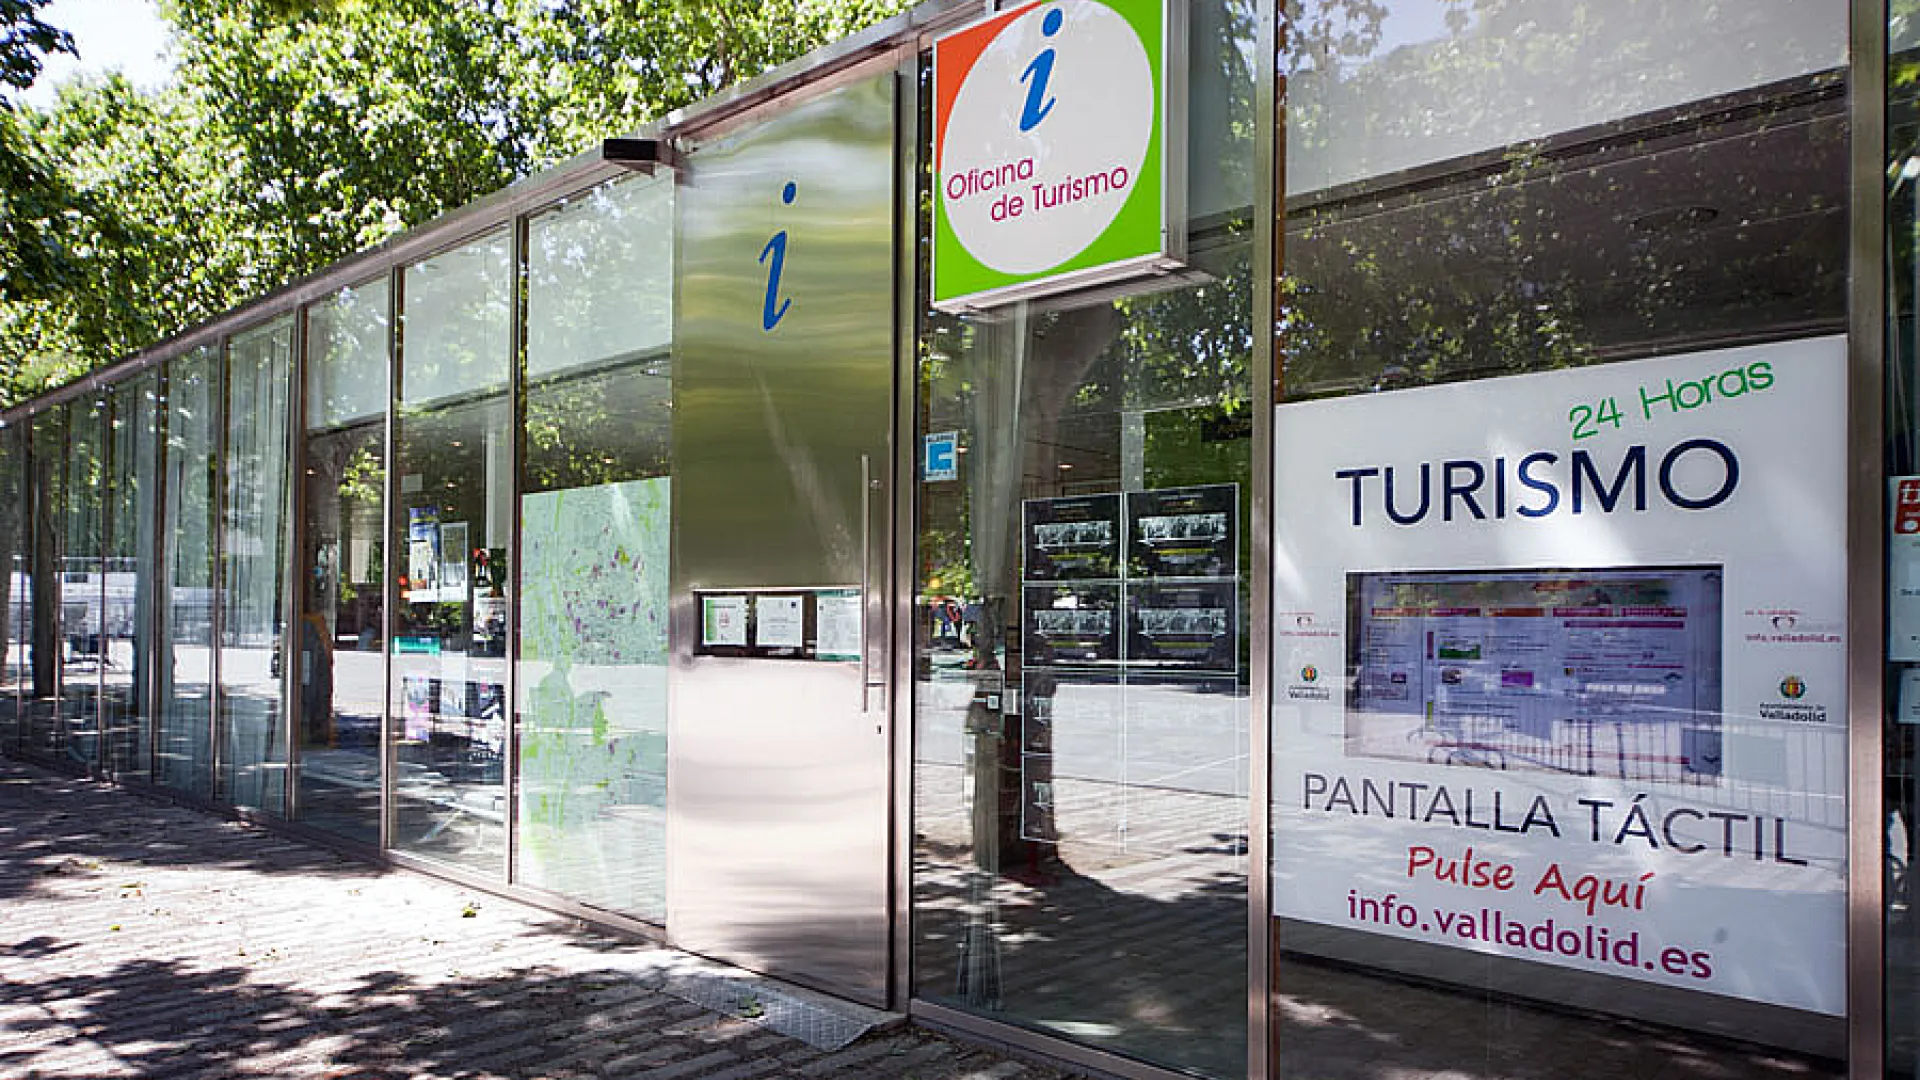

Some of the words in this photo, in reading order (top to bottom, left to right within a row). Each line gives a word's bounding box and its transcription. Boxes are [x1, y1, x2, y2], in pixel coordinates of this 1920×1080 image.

[946, 158, 1034, 200] Oficina
[991, 194, 1025, 222] de
[1032, 166, 1129, 211] Turismo
[1568, 397, 1624, 440] 24
[1639, 361, 1775, 420] Horas
[1335, 438, 1740, 527] TURISMO
[1303, 773, 1561, 838] PANTALLA
[1578, 793, 1808, 867] TÁCTIL
[1407, 845, 1516, 891] Pulse
[1533, 863, 1656, 917] Aquí
[1347, 889, 1713, 978] info.valladolid.es
